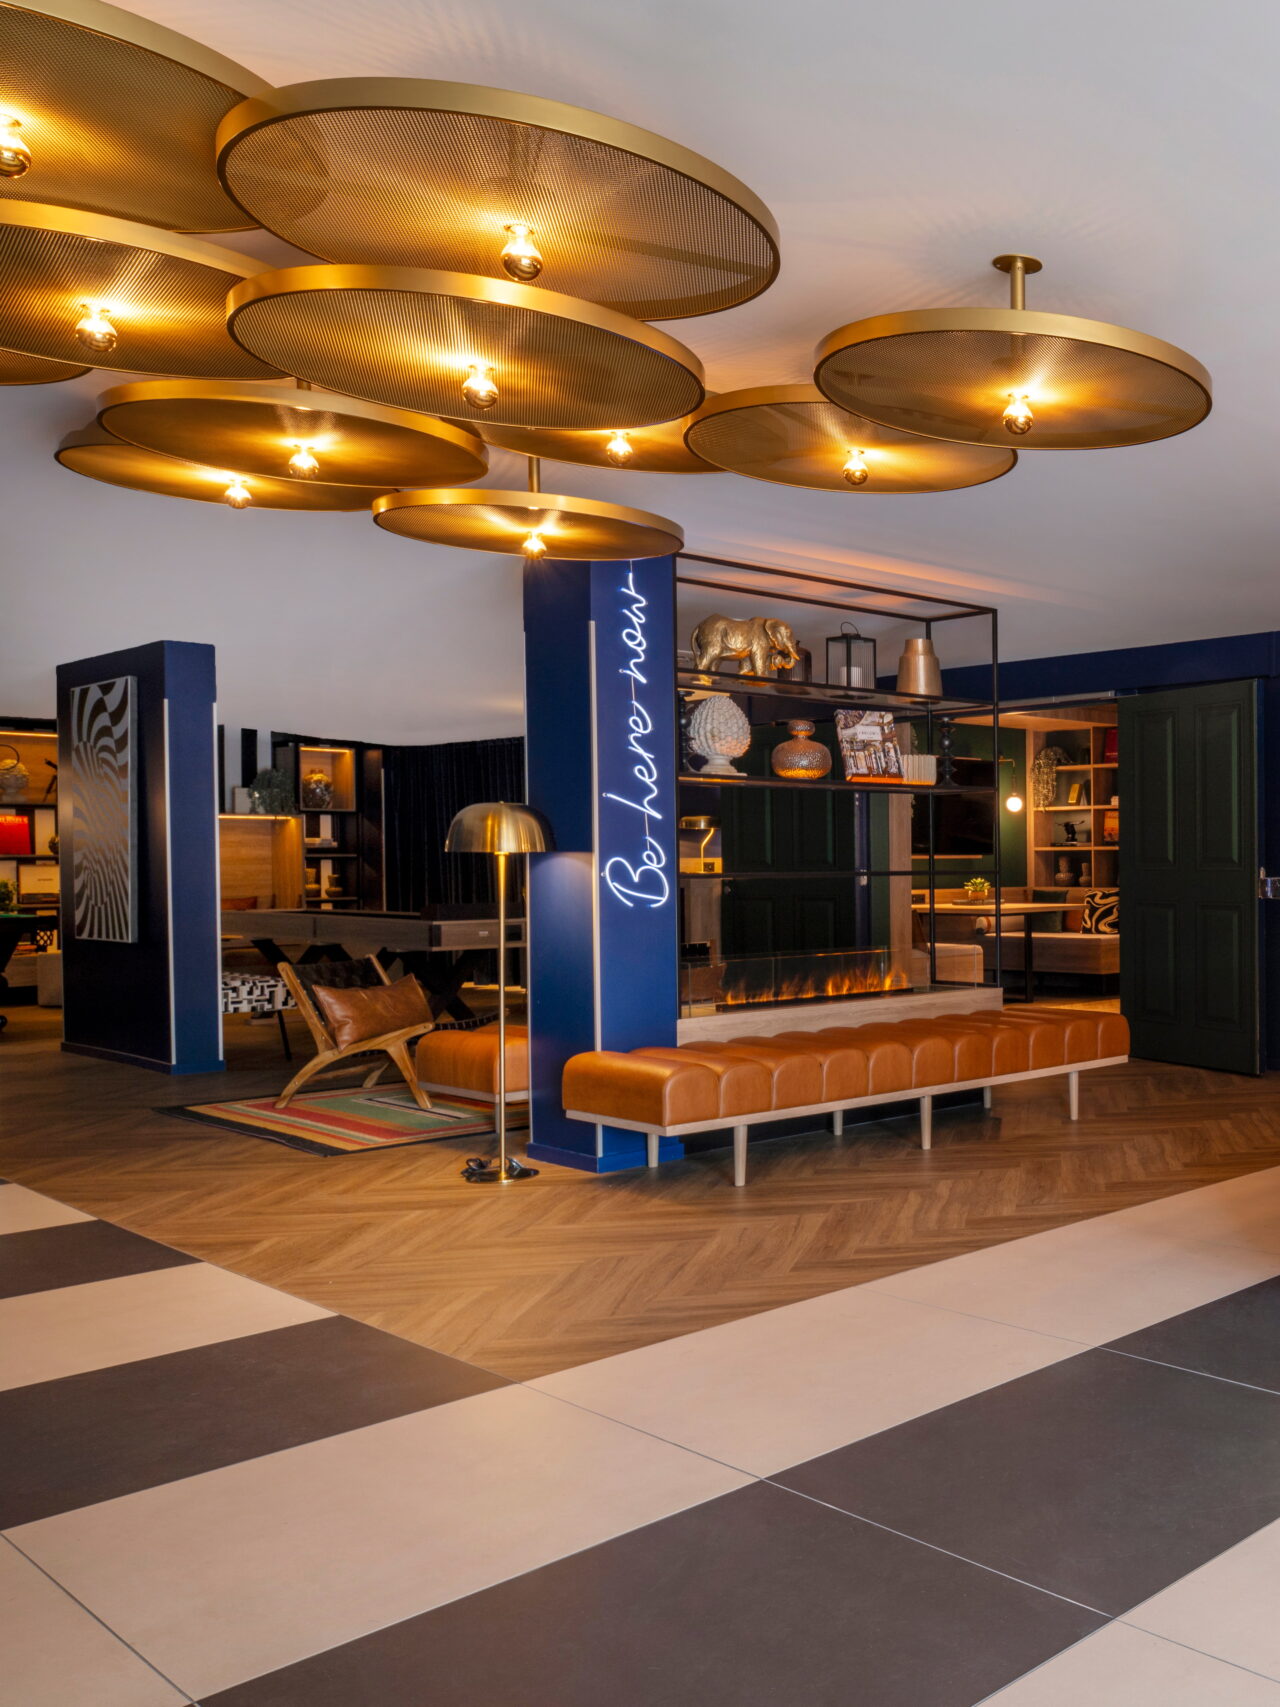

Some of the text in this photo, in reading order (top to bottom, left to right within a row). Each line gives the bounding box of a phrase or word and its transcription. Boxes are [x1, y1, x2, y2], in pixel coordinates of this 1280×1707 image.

[604, 571, 669, 908] Be here now
